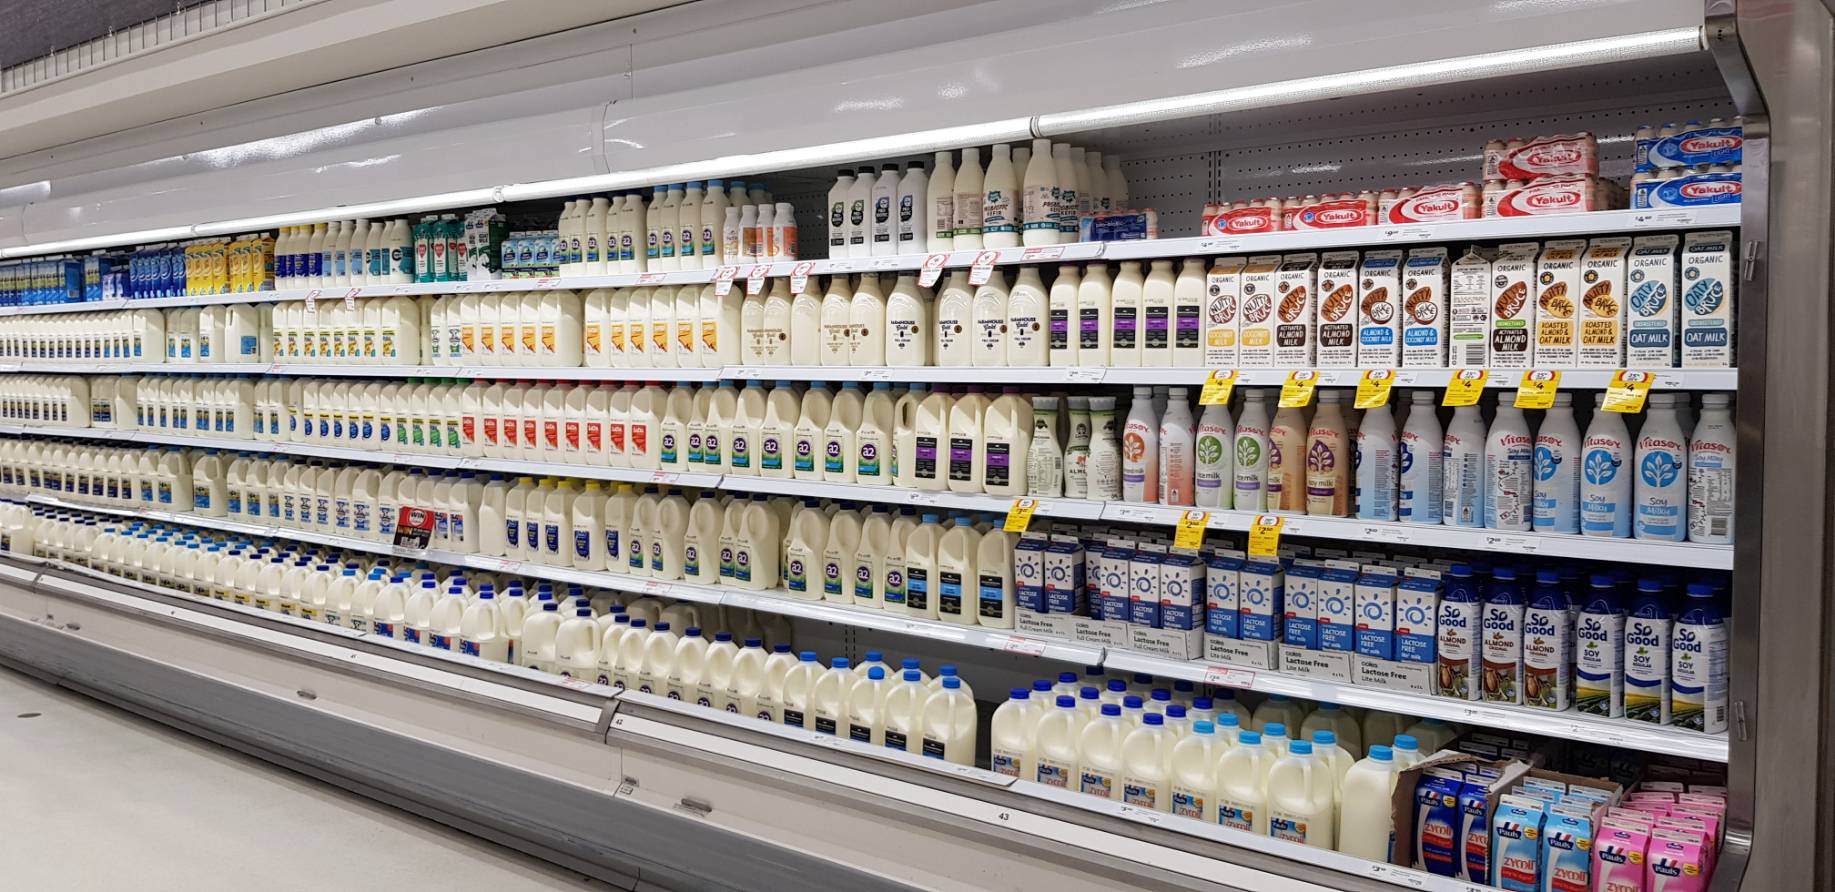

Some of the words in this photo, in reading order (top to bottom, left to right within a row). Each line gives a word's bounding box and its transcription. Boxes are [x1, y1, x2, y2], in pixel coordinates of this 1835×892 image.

[1690, 139, 1732, 150] Yakult
[1690, 184, 1733, 194] Yakult
[1535, 193, 1574, 205] Yakult
[1421, 203, 1453, 214] Yakult
[1323, 210, 1356, 222] Yakult
[1234, 219, 1261, 228] Yakult
[1587, 260, 1617, 268] ORGANIC
[1634, 258, 1667, 267] ORGANIC
[1688, 255, 1723, 264] ORGANIC
[1497, 264, 1526, 272] ORGANIC
[1279, 331, 1304, 339] ALMOND
[1322, 330, 1350, 338] ALMOND
[1494, 335, 1526, 343] ALMOND
[1632, 334, 1647, 343] OAT
[1648, 334, 1668, 343] MILK
[1686, 333, 1703, 342] OAT
[1704, 332, 1725, 342] MILK
[1540, 336, 1553, 344] OAT
[1553, 336, 1570, 344] MILK
[1583, 336, 1597, 344] OAT
[1597, 335, 1615, 344] MILK
[1533, 381, 1544, 390] $4
[1623, 383, 1635, 391] $4
[1639, 437, 1682, 450] Vitasoy
[1692, 440, 1731, 454] Vitasoy
[1590, 493, 1605, 503] Soy
[1650, 497, 1667, 506] Soy
[411, 511, 424, 519] WIN
[1444, 605, 1461, 618] So
[1490, 609, 1508, 621] So
[1244, 617, 1265, 626] LACTOSE
[1439, 615, 1466, 628] Good
[1484, 618, 1514, 631] Good
[1531, 613, 1549, 626] So
[1585, 618, 1601, 631] So
[1288, 622, 1312, 631] LACTOSE
[1525, 623, 1555, 636] Good
[1634, 623, 1652, 636] So
[1076, 628, 1098, 637] Lactose
[1099, 630, 1111, 638] Free
[1322, 627, 1346, 637] LACTOSE
[1578, 628, 1608, 641] Good
[1679, 628, 1696, 641] So
[1133, 636, 1156, 645] Lactose
[1156, 639, 1170, 647] Free
[1360, 633, 1385, 643] LACTOSE
[1401, 638, 1427, 648] LACTOSE
[1440, 636, 1466, 645] ALMOND
[1626, 632, 1659, 647] Good
[1484, 640, 1514, 648] ALMOND
[1525, 645, 1555, 653] ALMOND
[1673, 638, 1702, 653] Good
[1210, 645, 1234, 654] Lactose
[1235, 648, 1249, 657] Free
[1584, 649, 1600, 657] SOY
[1286, 657, 1312, 666] Lactose
[1313, 660, 1329, 668] Free
[1633, 655, 1651, 664] SOY
[1678, 661, 1694, 669] SOY
[1361, 667, 1389, 678] Lactose
[1390, 671, 1407, 680] Free
[1463, 806, 1484, 815] Pauls
[998, 813, 1010, 822] 43
[1424, 823, 1452, 837] zymil
[1499, 829, 1519, 839] Pauls
[1550, 839, 1571, 849] Pauls
[1601, 853, 1624, 863] Pauls
[1504, 857, 1534, 870] zymil
[1555, 867, 1586, 882] zymil
[1655, 866, 1678, 875] Pauls
